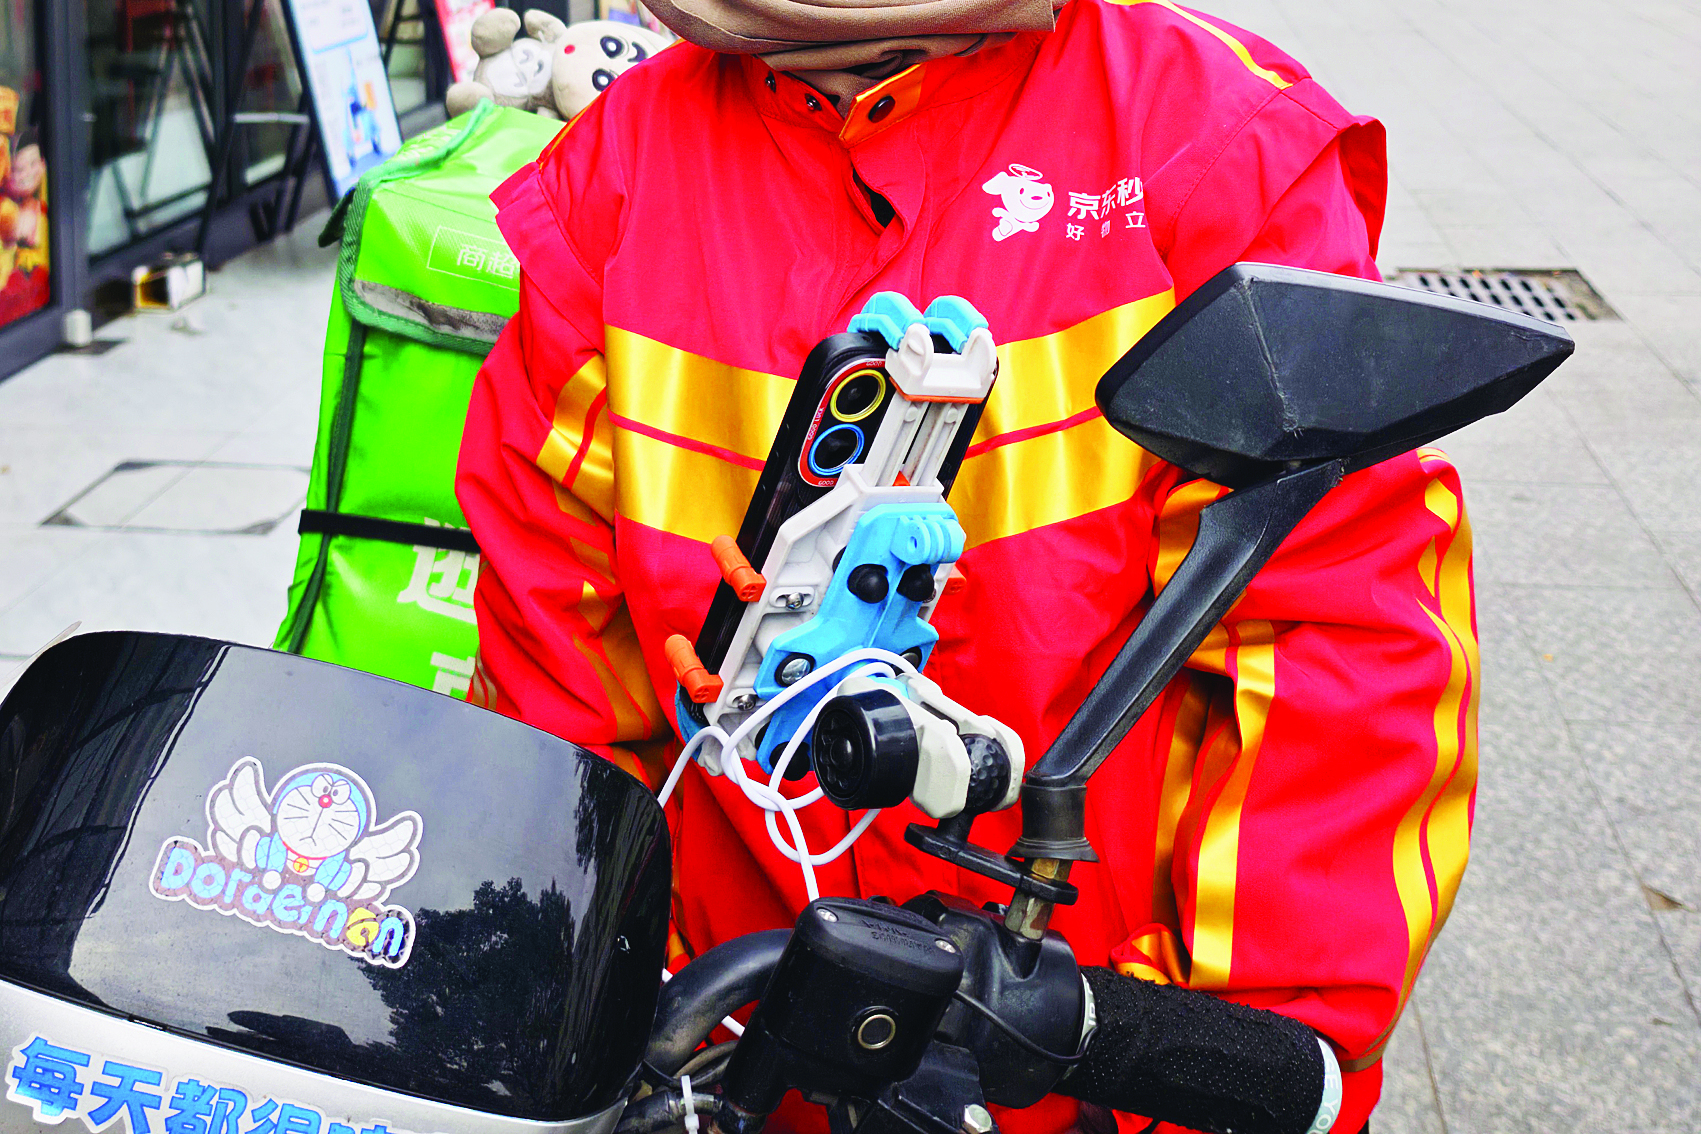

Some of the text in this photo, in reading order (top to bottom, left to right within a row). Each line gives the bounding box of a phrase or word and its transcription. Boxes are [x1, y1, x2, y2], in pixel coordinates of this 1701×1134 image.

[1067, 177, 1144, 220] 京东秒
[456, 243, 520, 279] 商超
[1308, 1099, 1339, 1134] YO
